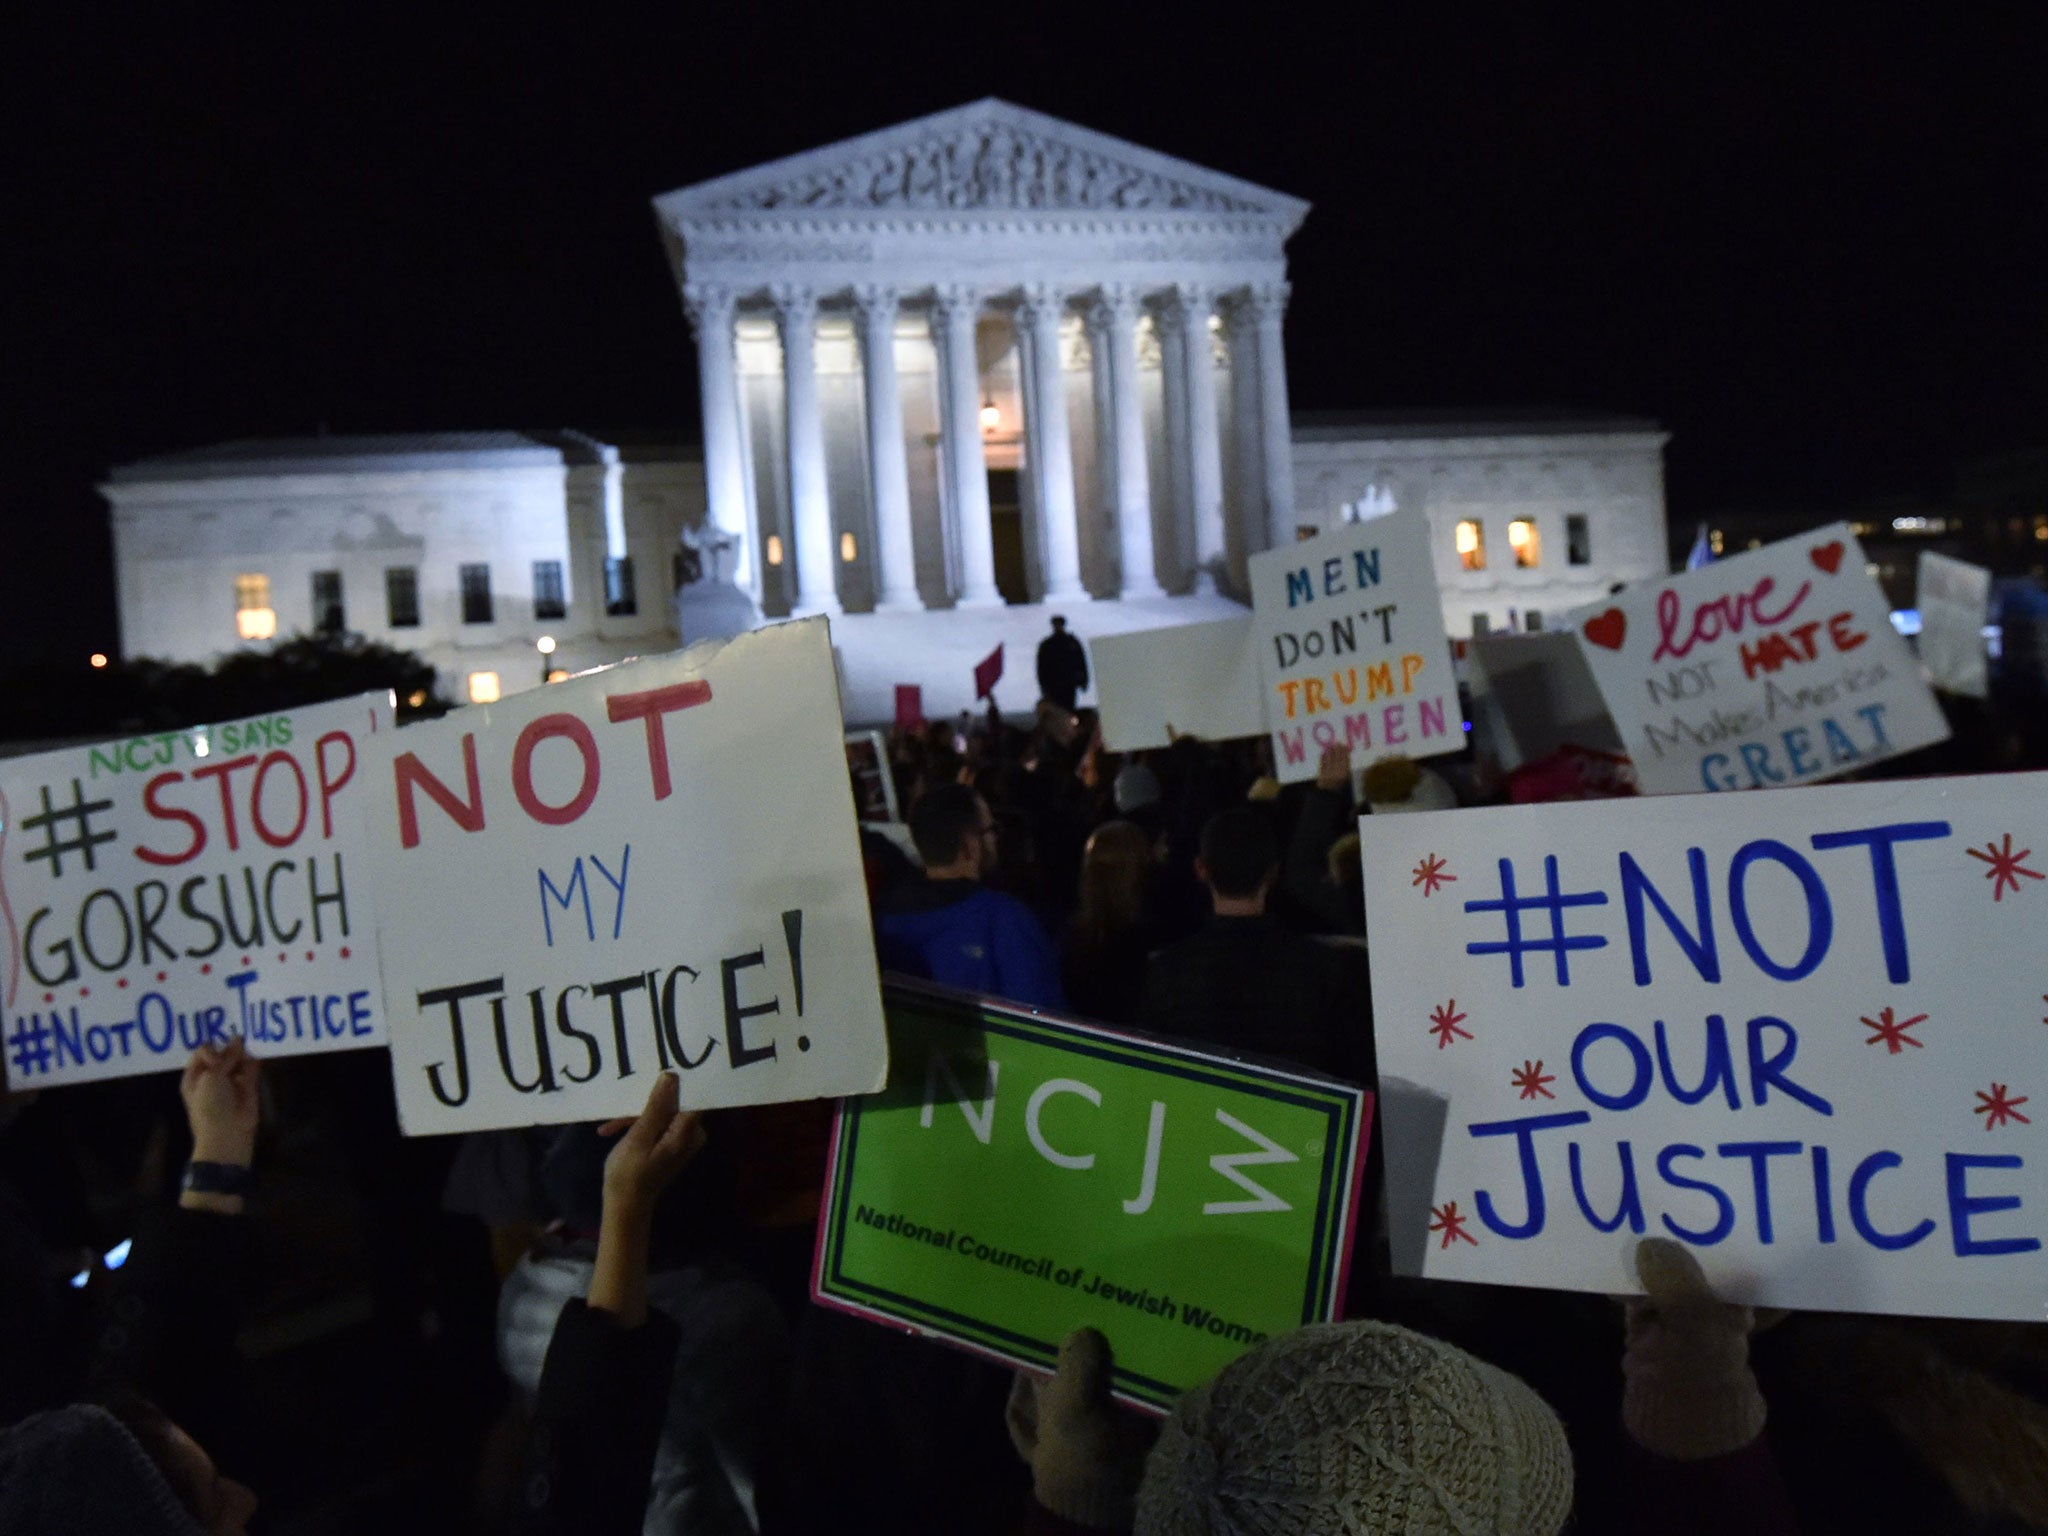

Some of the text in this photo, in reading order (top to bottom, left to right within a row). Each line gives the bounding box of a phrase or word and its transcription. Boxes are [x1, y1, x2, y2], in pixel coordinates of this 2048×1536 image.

[1286, 548, 1382, 608] MEN
[1273, 605, 1398, 669] DON'T
[1277, 654, 1425, 719] TRUMP
[1645, 611, 1870, 706] NOT HATE
[89, 716, 293, 779] NCJW SAYS
[393, 679, 713, 850] NOT
[1279, 697, 1447, 766] WOMEN
[1701, 703, 1892, 792] GREAT
[20, 731, 357, 878] #STOP
[24, 852, 350, 988] GORSUCH
[537, 843, 631, 947] MY
[1464, 821, 1952, 989] #NOT
[416, 909, 812, 1108] JUSTICE!
[1570, 1014, 1834, 1117] OUR
[919, 1043, 1300, 1216] NCJW
[1467, 1110, 2043, 1258] JUSTICE
[856, 1204, 956, 1250] National
[957, 1235, 1055, 1282] Council
[1055, 1265, 1084, 1288] of
[1082, 1274, 1177, 1320] Jewish
